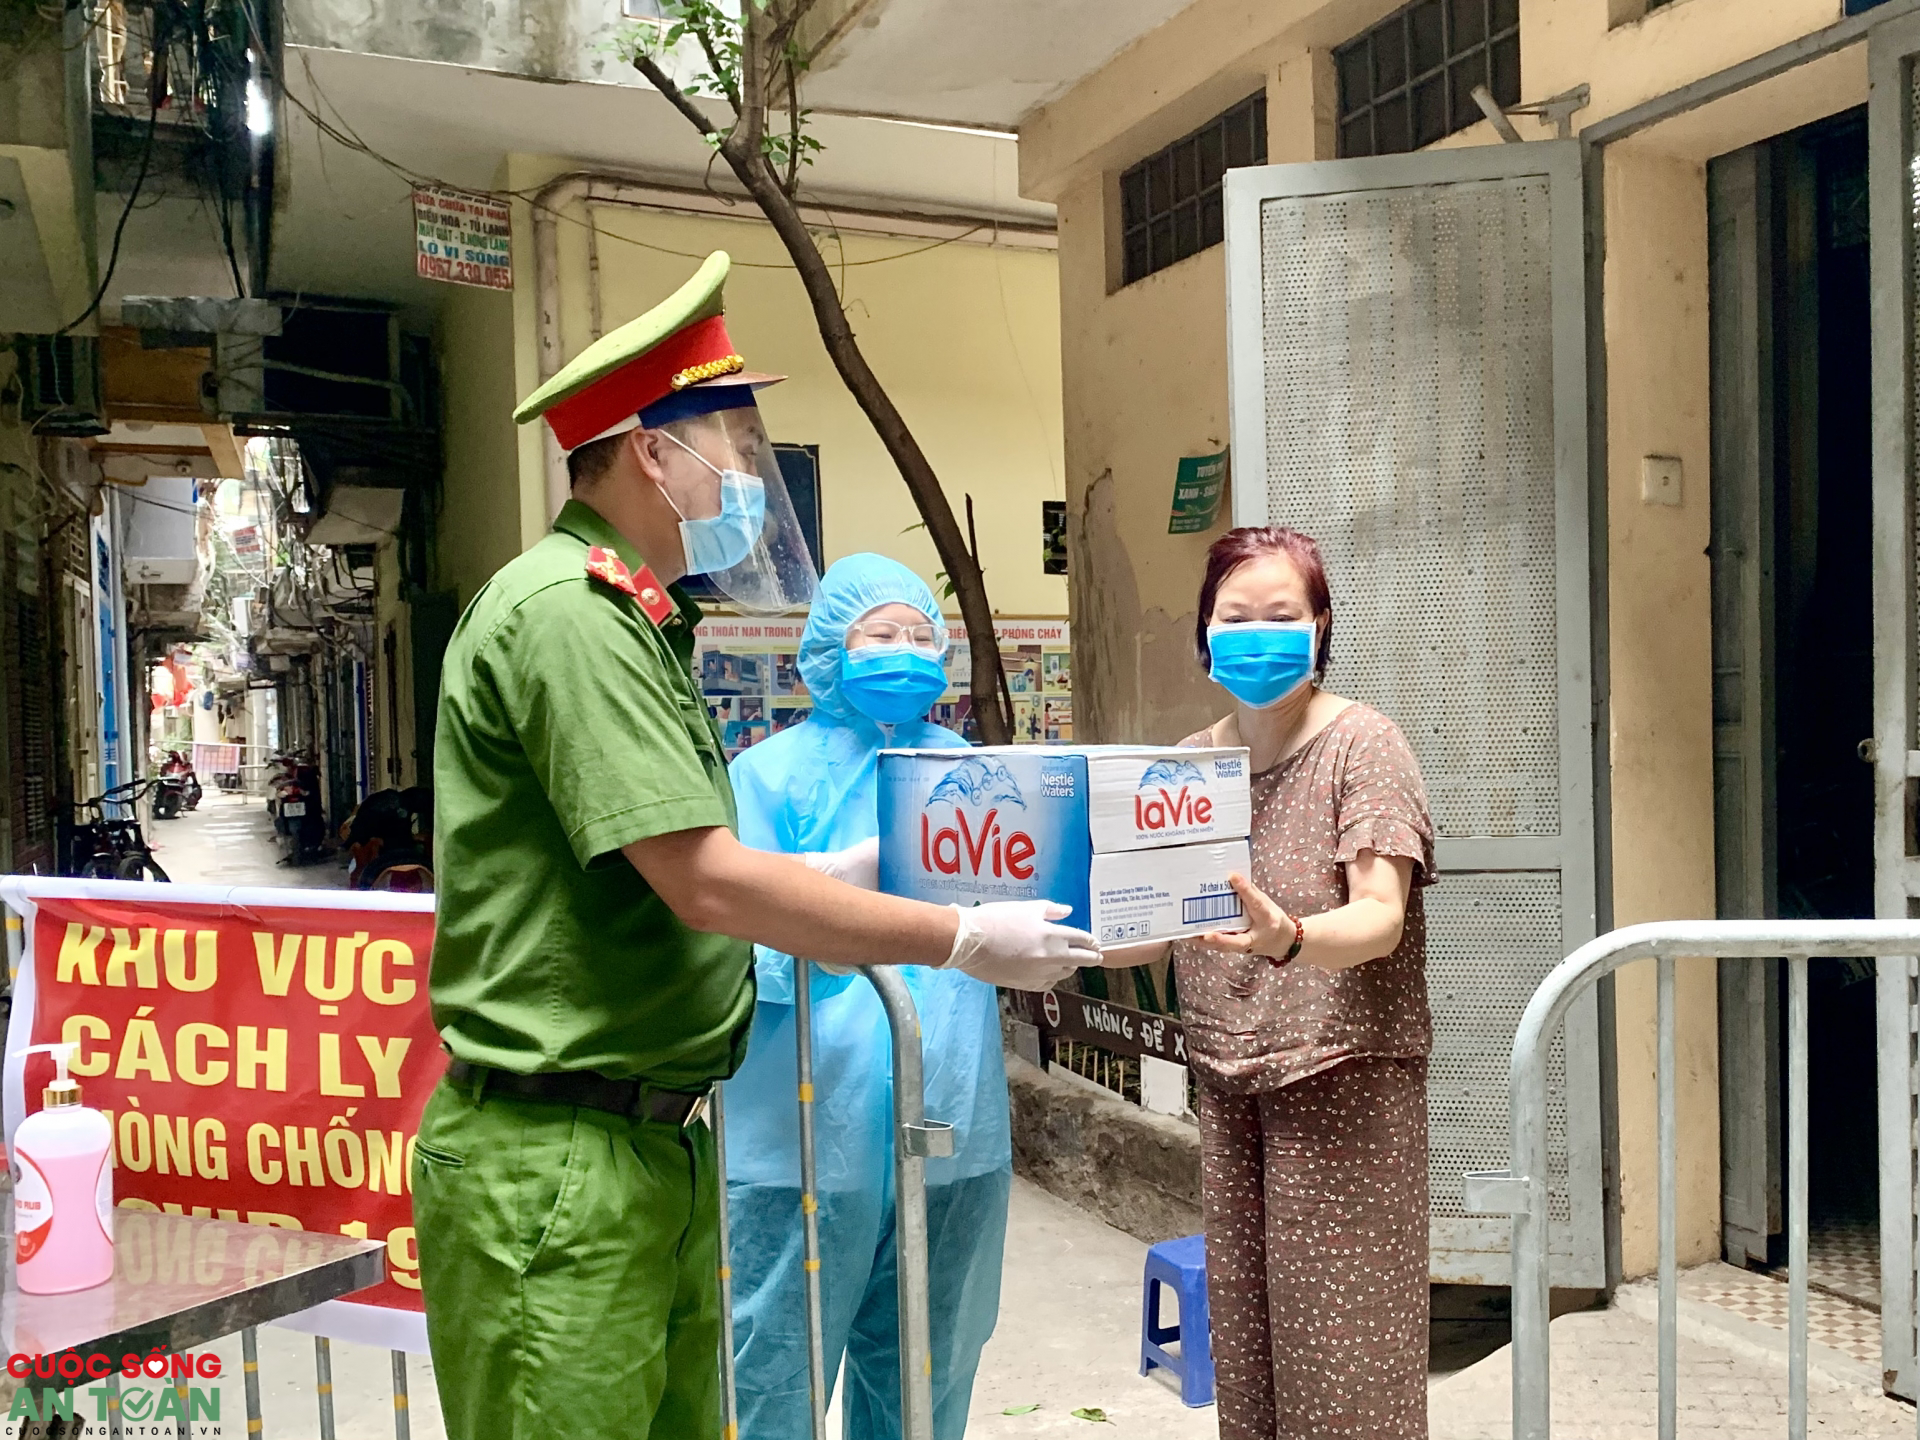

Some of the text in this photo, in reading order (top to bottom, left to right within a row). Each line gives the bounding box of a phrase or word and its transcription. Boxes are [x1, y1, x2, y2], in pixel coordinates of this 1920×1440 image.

[444, 245, 459, 259] VI
[711, 624, 739, 638] THOÁT
[742, 626, 761, 640] NẠN
[764, 626, 793, 638] TRONG
[1037, 626, 1062, 639] CHÁY
[1214, 759, 1242, 771] Nestlé
[1041, 772, 1075, 786] Nestlé
[1215, 769, 1243, 779] Waters
[1041, 785, 1075, 798] Waters
[1199, 883, 1207, 893] 24
[1208, 881, 1219, 892] chai
[56, 922, 417, 1016] KHU VỰC
[1082, 1003, 1188, 1062] KHÔNG ĐỂ X
[61, 1005, 412, 1098] CÁCH LY
[112, 1096, 416, 1196] ÒNG CHỐN
[24, 1200, 41, 1210] RUB
